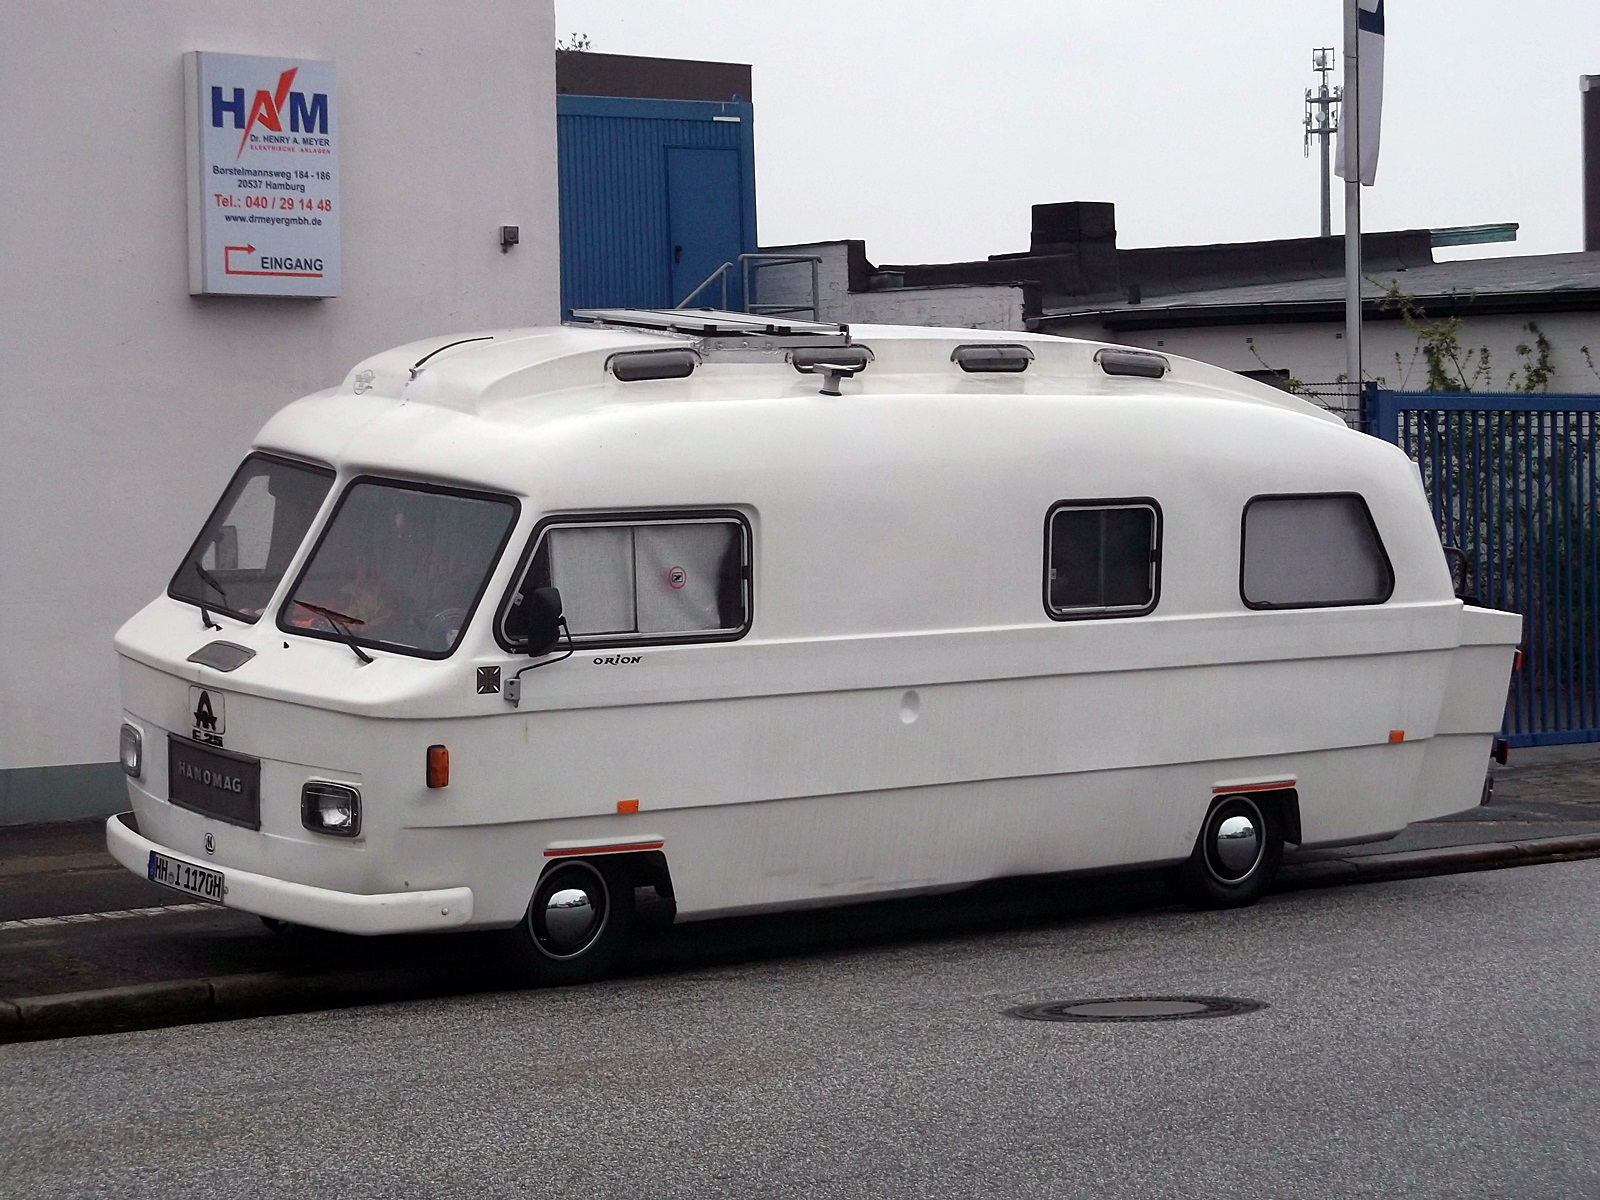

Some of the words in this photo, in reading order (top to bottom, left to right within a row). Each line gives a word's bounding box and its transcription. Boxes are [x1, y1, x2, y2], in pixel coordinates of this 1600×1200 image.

[249, 134, 261, 143] Dr.
[263, 135, 290, 145] HENRY
[302, 138, 330, 147] MEYER
[250, 144, 296, 153] ELEKTRISCHE
[300, 147, 331, 155] ANLAGEN
[212, 165, 292, 180] Borstelmannsweg
[294, 170, 309, 179] 184
[316, 171, 331, 181] 186
[238, 179, 263, 189] 20537
[265, 181, 306, 193] Hamburg
[214, 194, 241, 208] Tel.:
[245, 196, 268, 209] 040
[271, 197, 276, 209] /
[280, 197, 294, 210] 29
[299, 198, 313, 211] 14
[317, 199, 332, 212] 48
[224, 213, 323, 227] www.drmeyergmbh.de
[261, 256, 324, 271] EINGANG
[179, 761, 242, 793] HANOMAG
[155, 856, 169, 882] HH
[175, 863, 181, 886] I
[184, 867, 222, 898] 1170H
